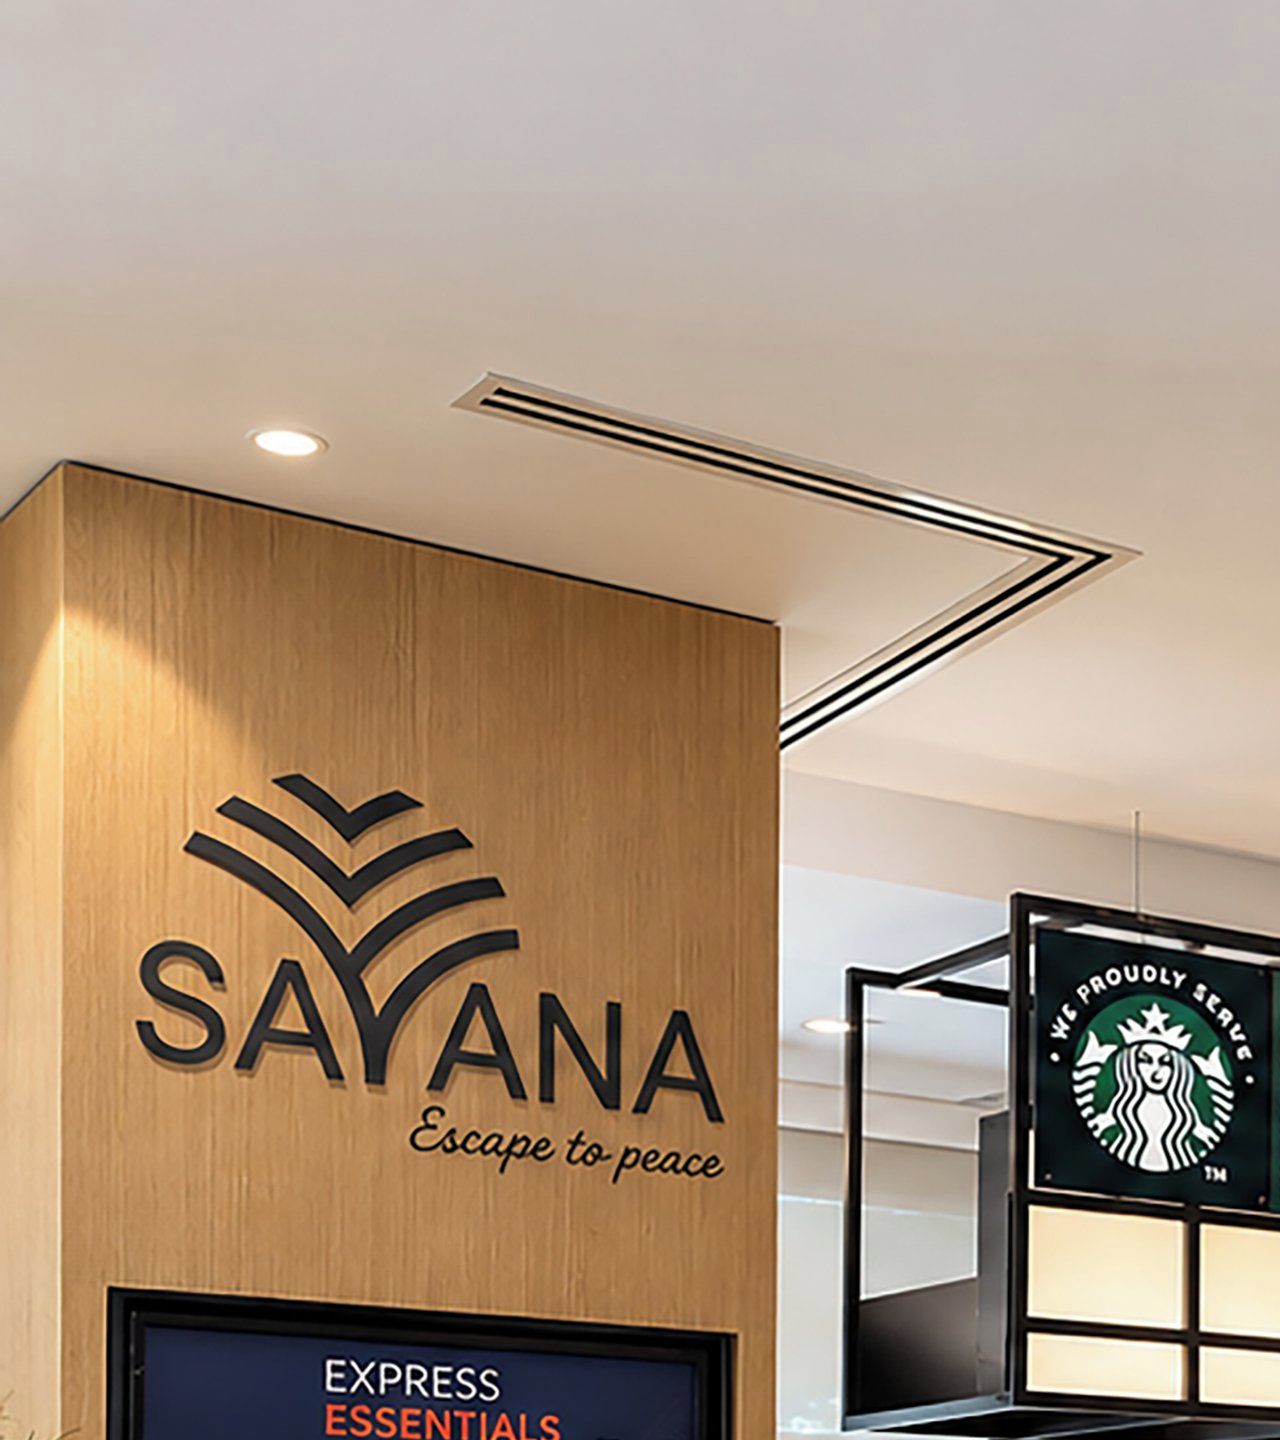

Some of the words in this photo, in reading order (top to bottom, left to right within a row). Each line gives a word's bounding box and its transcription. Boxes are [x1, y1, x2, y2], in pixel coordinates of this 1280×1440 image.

[1050, 1003, 1079, 1041] WE
[1076, 964, 1188, 1005] PROUDLY
[1192, 982, 1254, 1061] SERVE
[408, 1104, 556, 1174] Escape
[564, 1129, 612, 1167] to
[612, 1144, 726, 1185] peace
[324, 1359, 501, 1402] EXPRESS
